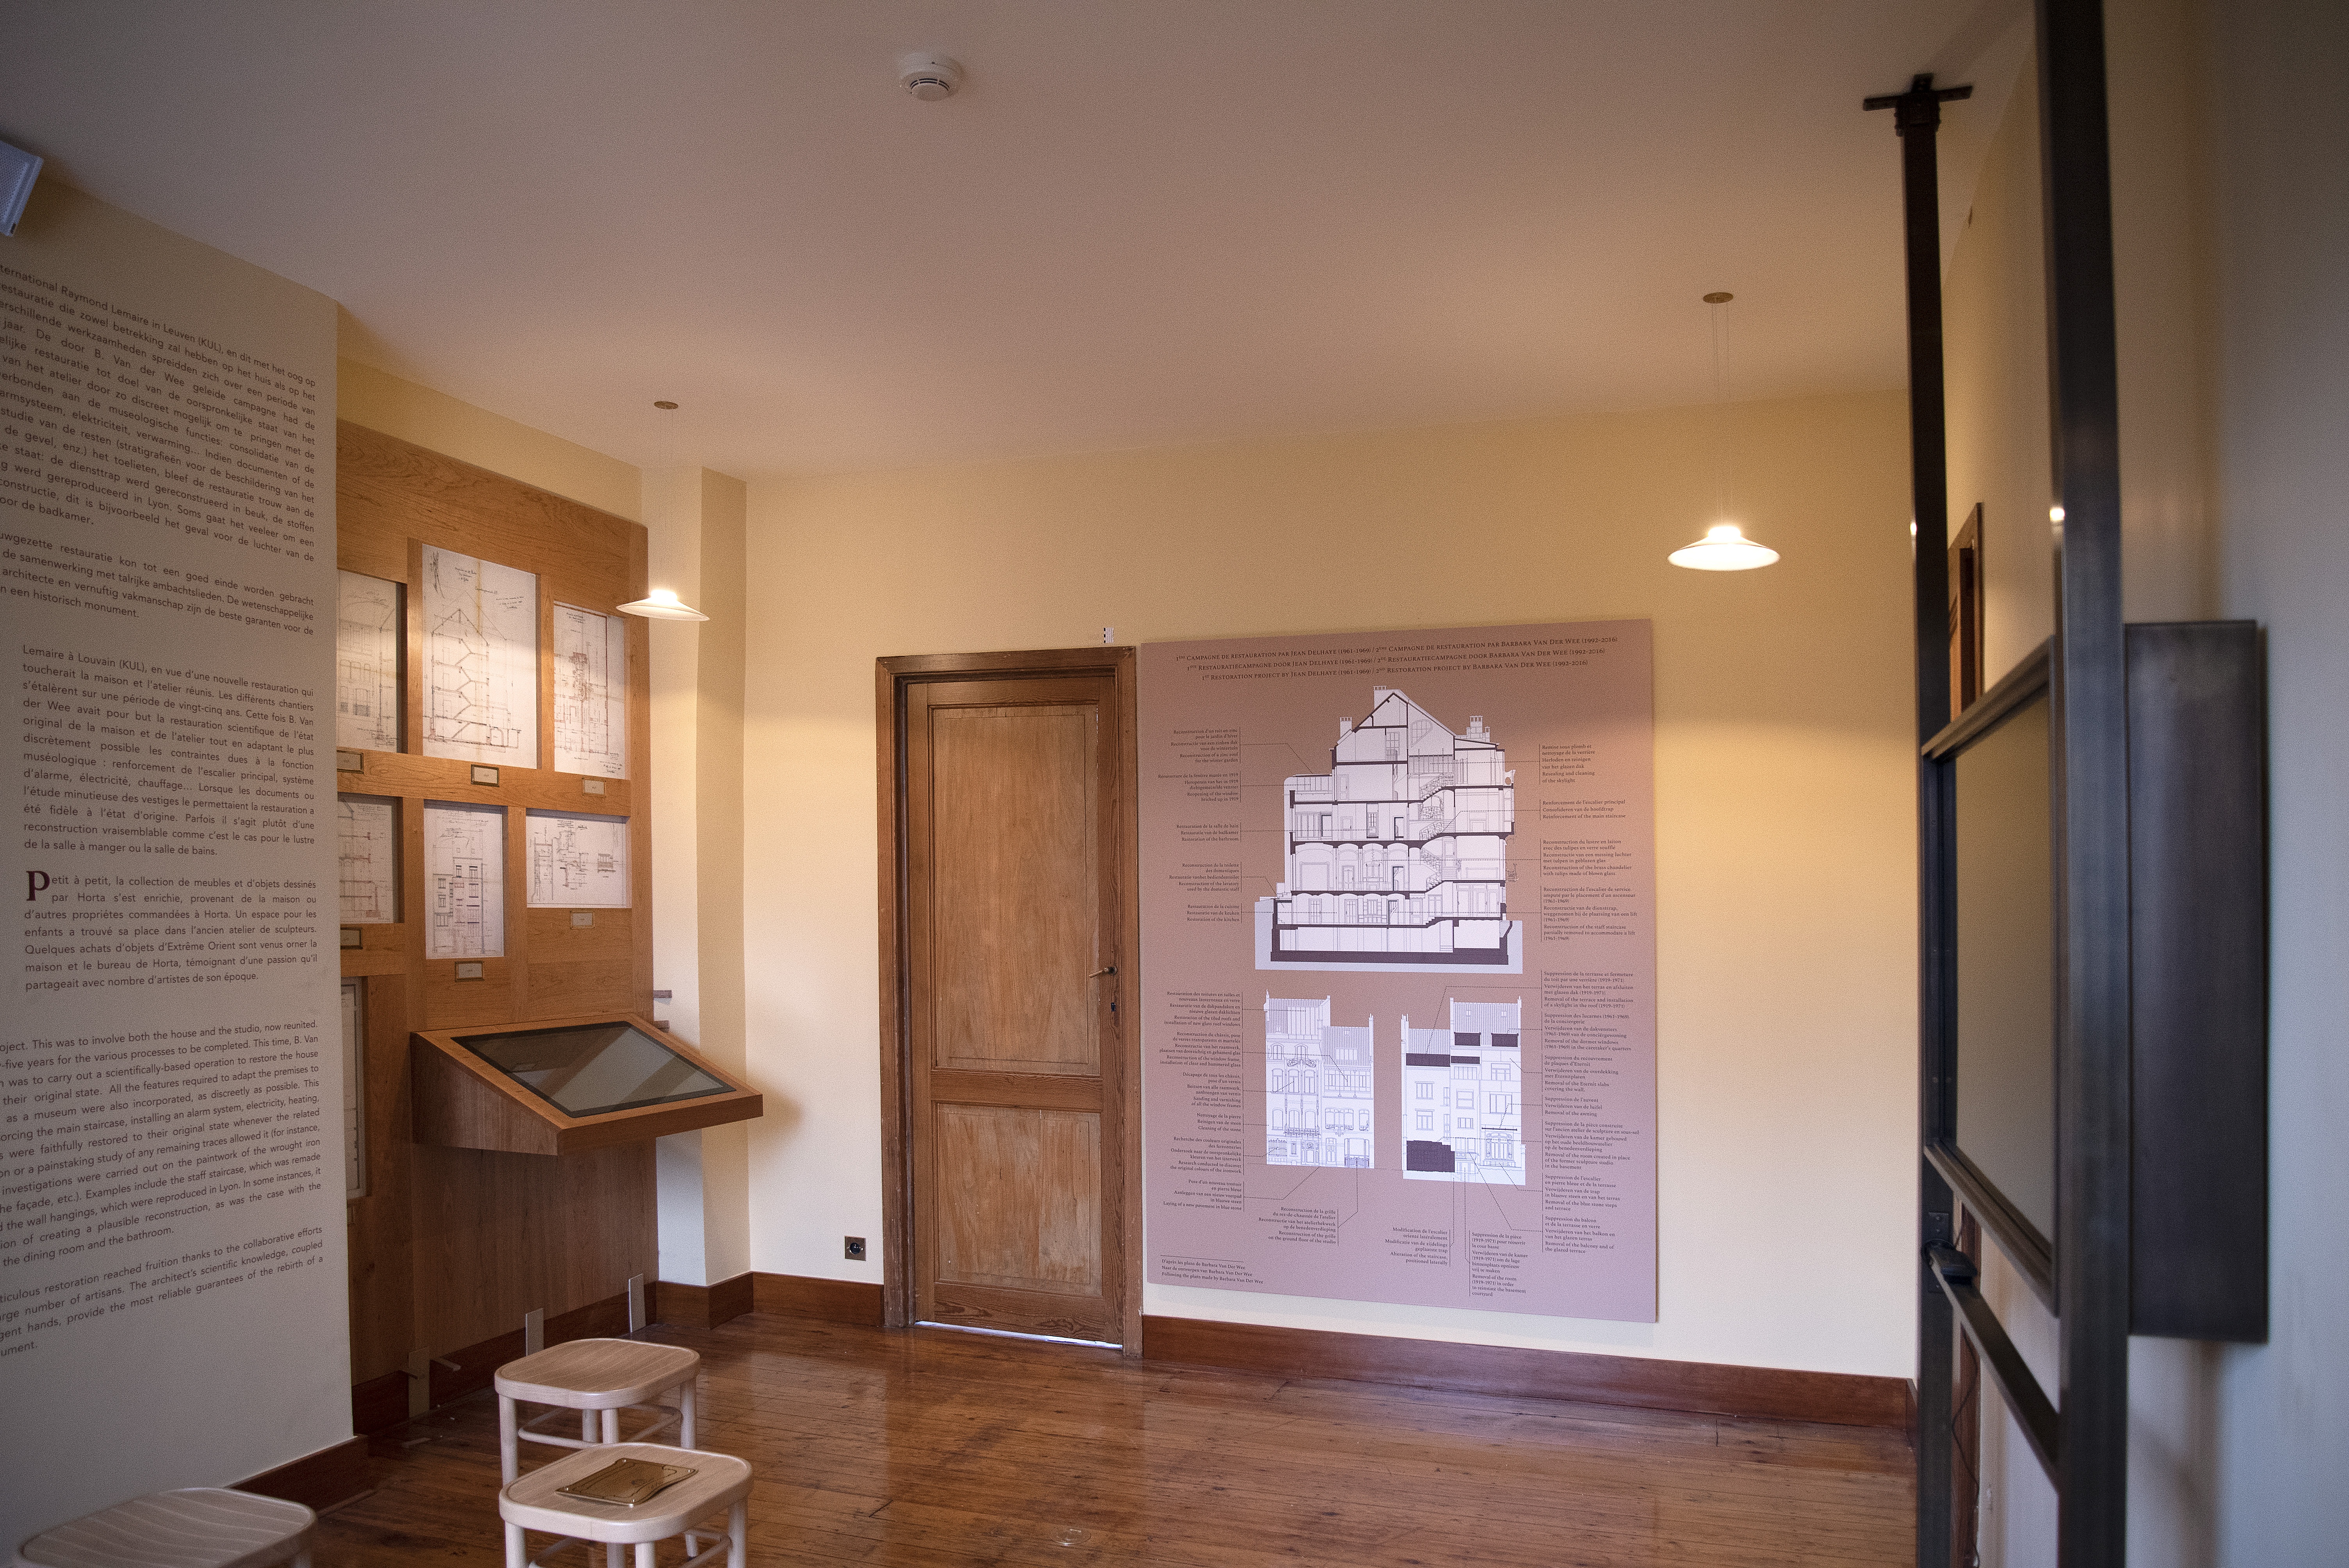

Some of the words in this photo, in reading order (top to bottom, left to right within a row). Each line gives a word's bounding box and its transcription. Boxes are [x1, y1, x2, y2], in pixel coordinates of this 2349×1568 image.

[2, 549, 16, 559] de
[20, 556, 93, 577] samenwerking
[96, 570, 115, 579] met
[118, 573, 150, 587] talrijke
[153, 581, 224, 601] ambachtslieden.
[227, 595, 239, 603] De
[242, 600, 314, 620] wetenschappelijke
[22, 644, 64, 661] Lemaire
[68, 651, 74, 663] à
[77, 652, 116, 669] Louvain
[119, 657, 147, 675] (KUL),
[150, 666, 162, 675] en
[166, 668, 182, 678] vue
[185, 667, 210, 682] d'une
[213, 675, 248, 687] nouvelle
[251, 679, 299, 694] restauration
[301, 686, 314, 698] qui
[1198, 662, 1272, 670] RESTAURATIECAMPAGNE
[1388, 654, 1467, 663] RESTAURATIECAMPAGNE
[74, 874, 80, 885] à
[84, 875, 110, 888] petit,
[116, 874, 124, 886] la
[128, 875, 174, 886] collection
[178, 875, 190, 886] de
[194, 876, 231, 887] meubles
[234, 877, 243, 887] et
[246, 876, 280, 890] d'objets
[283, 877, 316, 888] dessinés
[24, 942, 75, 957] Quelques
[80, 941, 111, 953] achats
[115, 941, 154, 955] d'objets
[158, 940, 205, 951] d'Extrême
[208, 940, 235, 950] Orient
[239, 939, 257, 950] sont
[310, 938, 317, 948] la
[33, 1036, 53, 1049] This
[55, 1038, 75, 1048] was
[78, 1035, 89, 1046] to
[91, 1032, 125, 1045] involve
[128, 1030, 150, 1042] both
[153, 1029, 168, 1041] the
[170, 1028, 197, 1039] house
[200, 1025, 216, 1037] and
[218, 1025, 232, 1036] the
[234, 1023, 262, 1035] studio,
[264, 1025, 282, 1033] now
[283, 1019, 317, 1032] reunited.
[3, 1252, 20, 1265] the
[23, 1247, 55, 1261] dining
[59, 1243, 84, 1255] room
[88, 1236, 105, 1249] and
[109, 1234, 123, 1246] the
[127, 1229, 174, 1242] bathroom.
